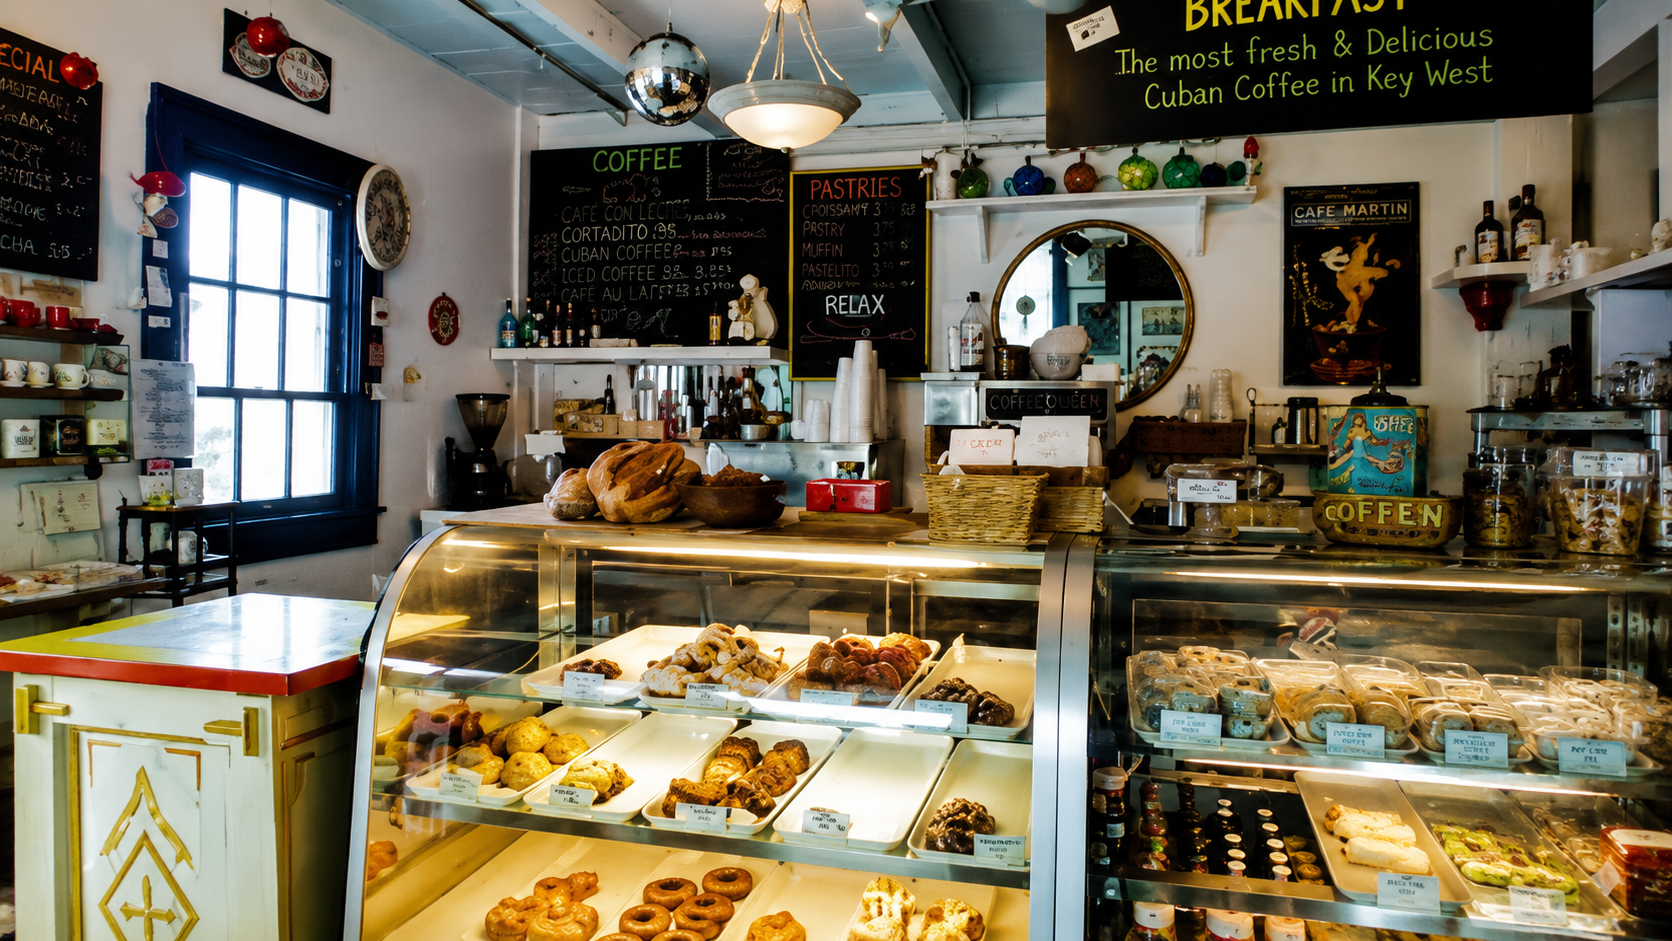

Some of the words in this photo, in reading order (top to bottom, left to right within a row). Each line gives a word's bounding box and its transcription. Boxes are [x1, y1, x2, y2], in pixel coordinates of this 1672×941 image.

[1115, 48, 1158, 75] The
[1170, 42, 1234, 71] most
[1246, 35, 1317, 65] fresh
[1333, 29, 1352, 58] &
[1367, 25, 1494, 55] Delicious
[1144, 79, 1223, 110] Cuban
[1234, 71, 1320, 101] Coffee
[1332, 70, 1355, 93] in
[1368, 63, 1414, 98] Key
[1424, 55, 1494, 87] West
[592, 146, 683, 172] COFFEE
[810, 176, 902, 200] PASTRIES
[604, 204, 633, 221] CON
[1294, 205, 1336, 219] CAFE
[1343, 202, 1408, 217] MARTIN
[561, 223, 648, 244] CORTADITO
[802, 220, 846, 237] PASTRY
[561, 247, 610, 263] CUBAN
[616, 243, 672, 261] COFFEE
[801, 242, 843, 258] MUFFIN
[601, 265, 656, 281] COFFEE
[801, 263, 860, 277] PASTELITO
[602, 286, 622, 301] AU
[825, 294, 886, 316] RELAX
[989, 394, 1044, 411] COFFEE
[1325, 501, 1443, 528] COFFEN
